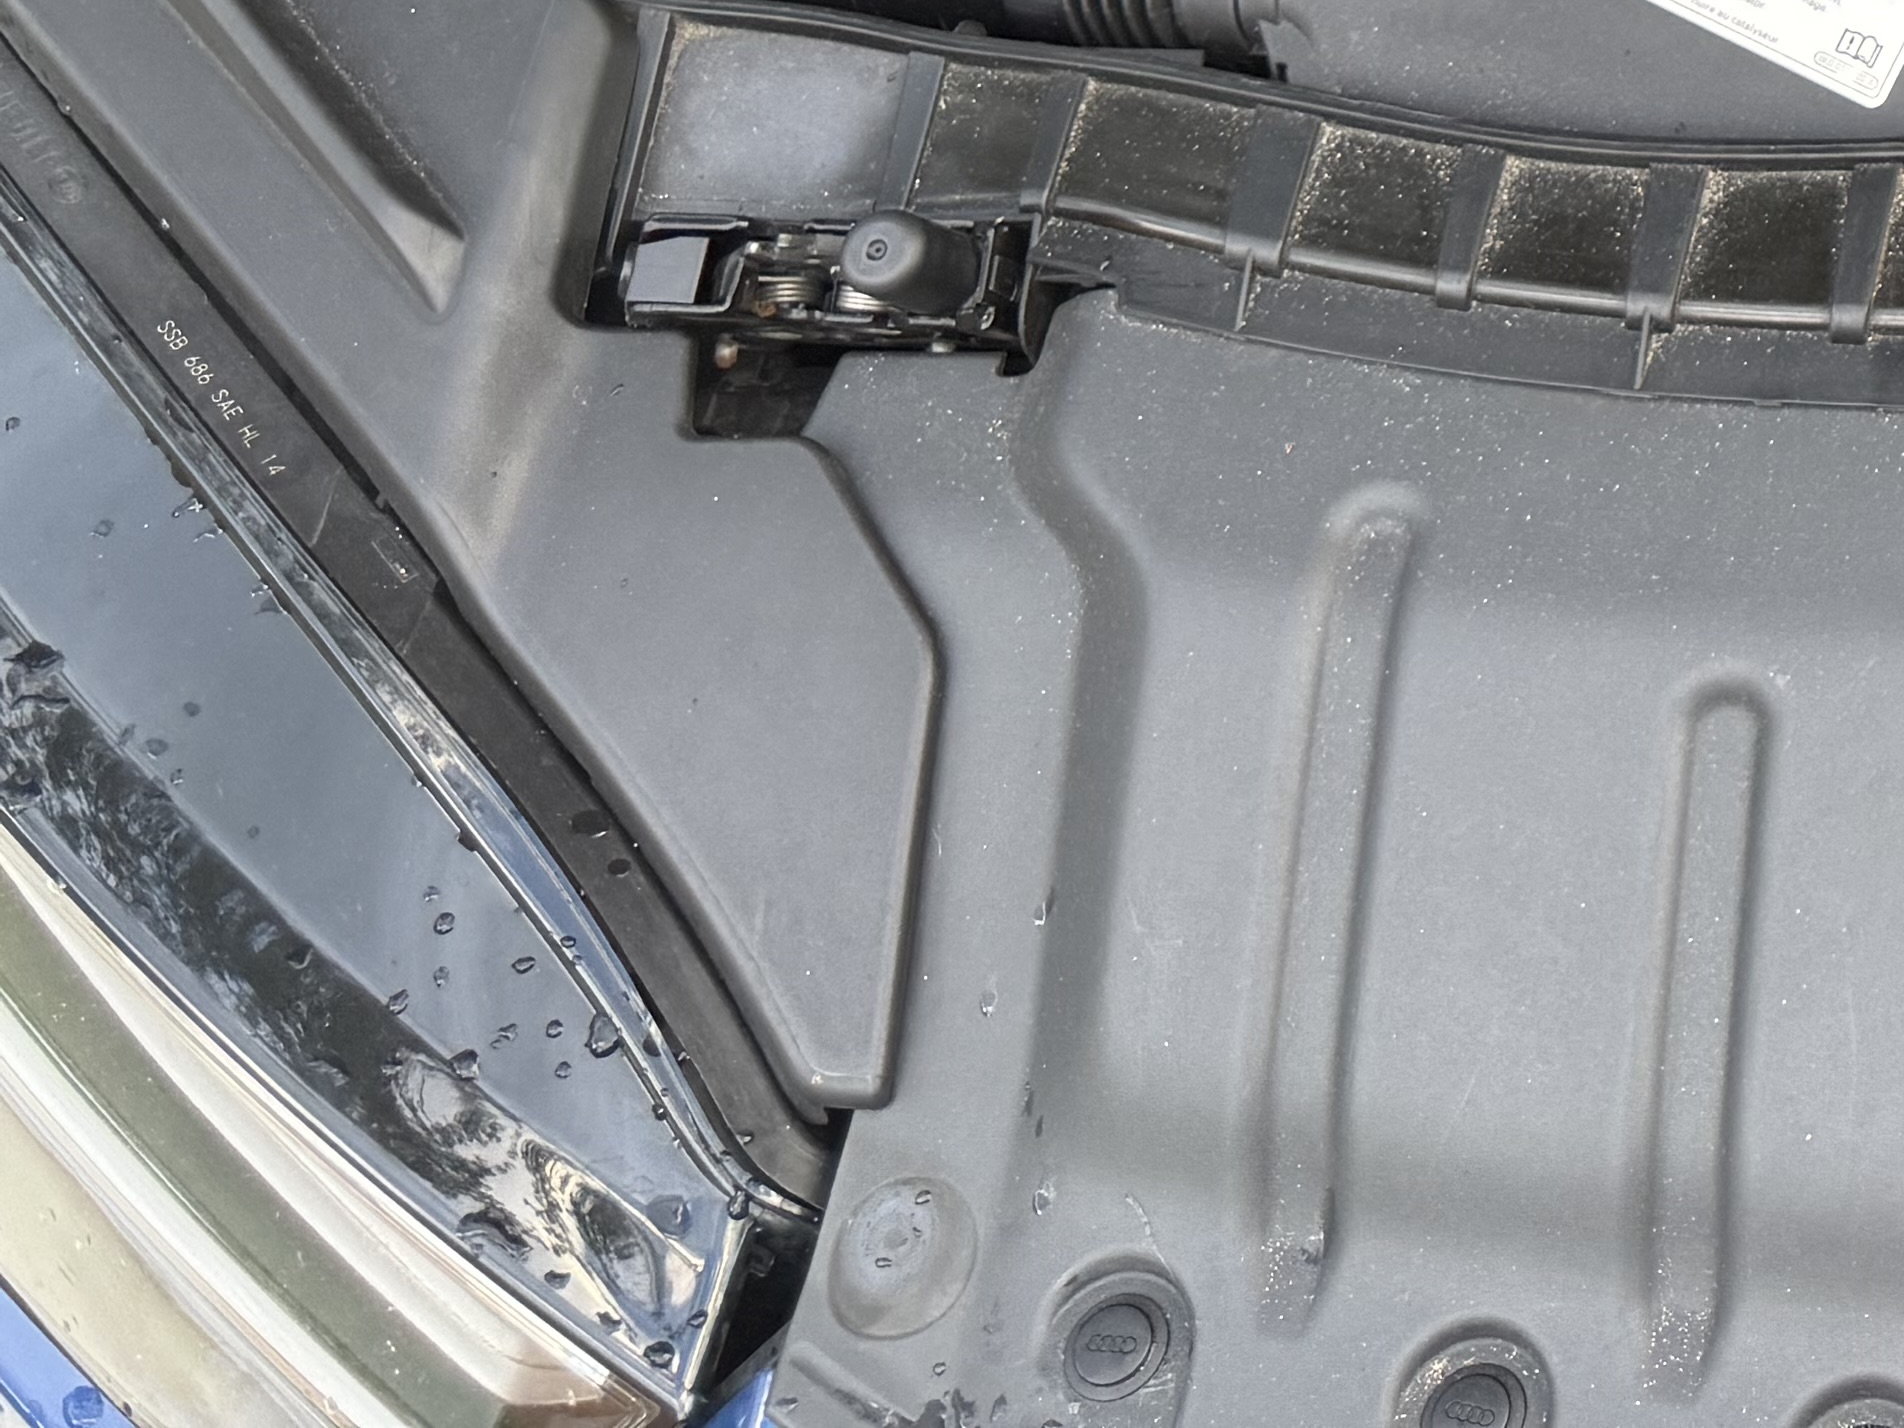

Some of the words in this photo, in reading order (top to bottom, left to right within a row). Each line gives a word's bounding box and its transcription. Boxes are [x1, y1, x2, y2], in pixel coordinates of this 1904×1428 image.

[157, 320, 188, 350] SSB
[184, 356, 214, 384] 686
[211, 389, 244, 421] SAE
[238, 424, 260, 449] HL
[260, 454, 286, 476] 14
